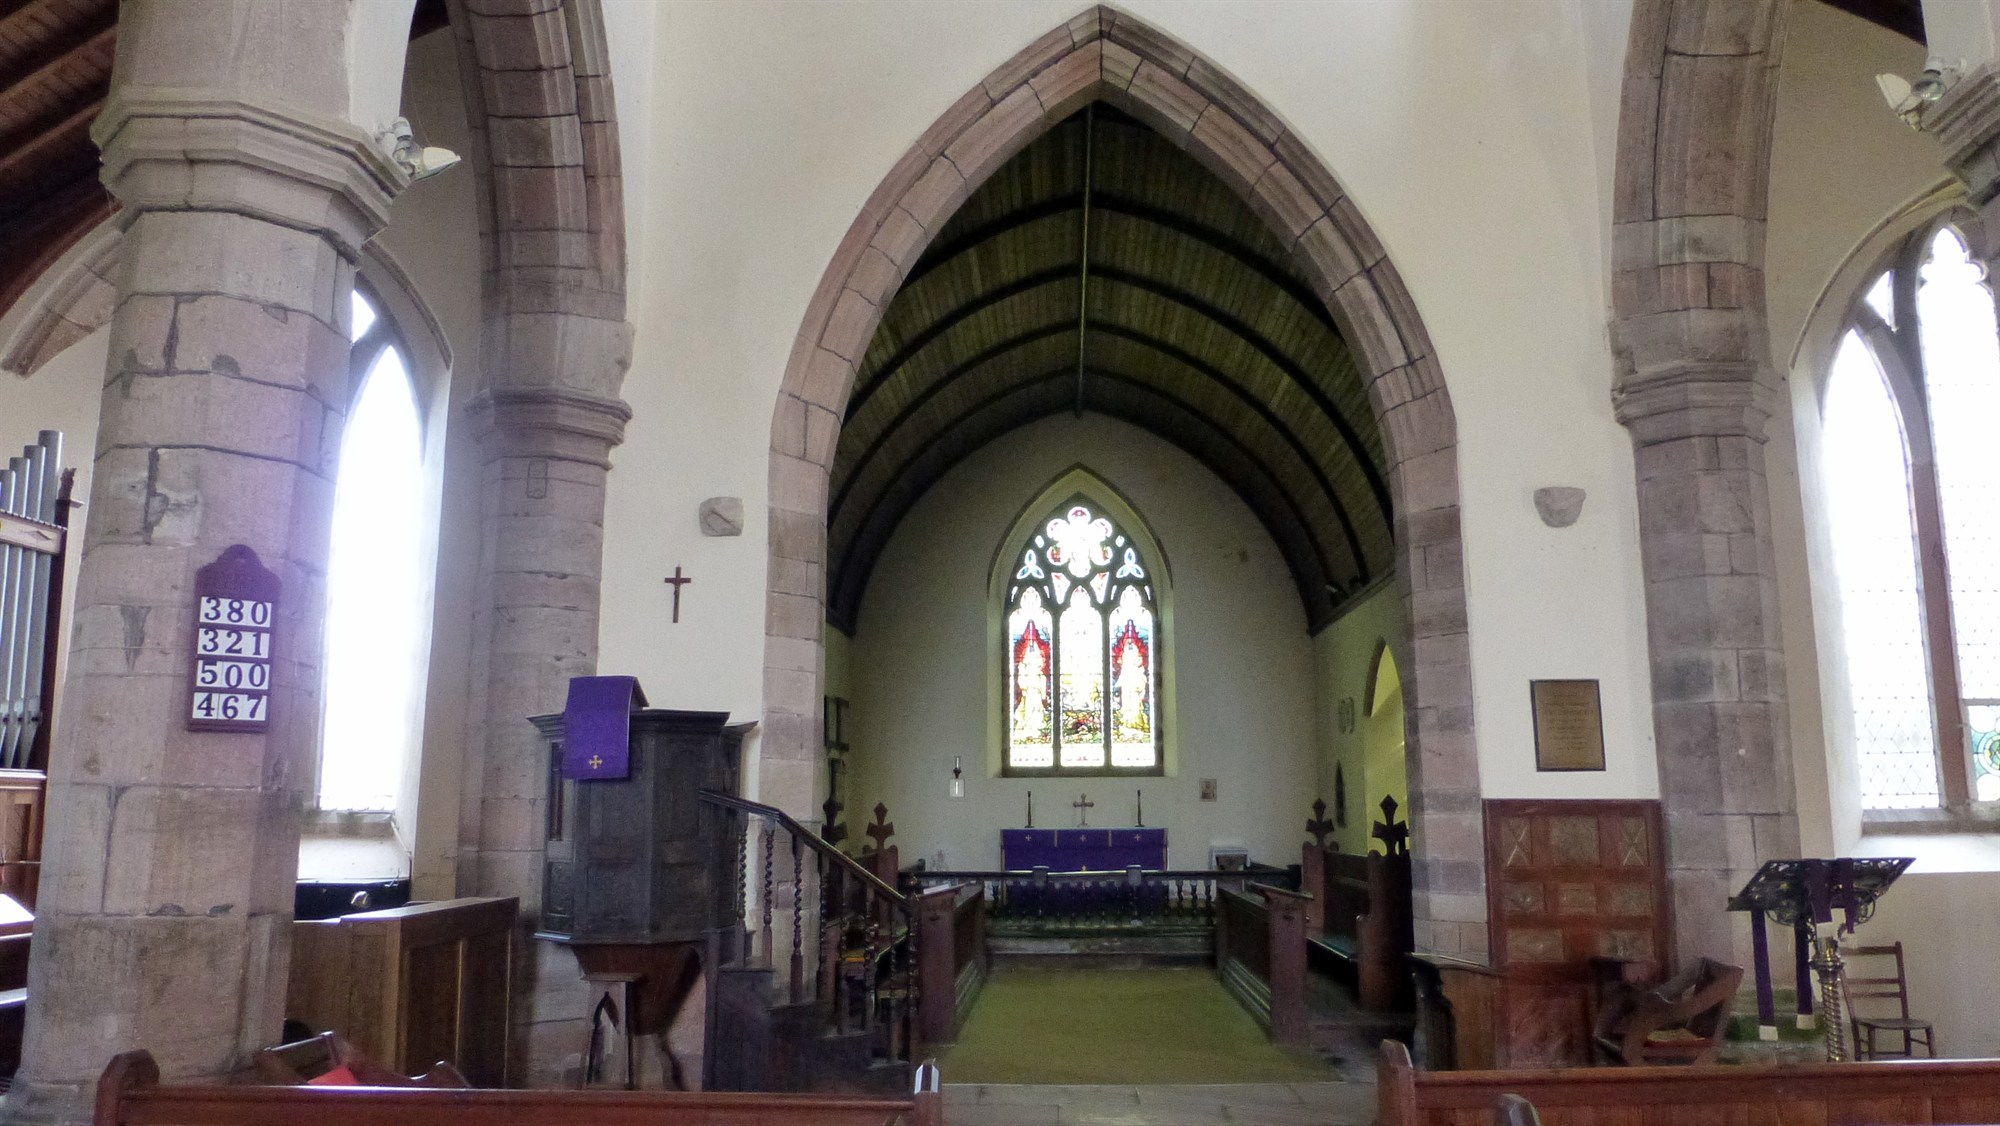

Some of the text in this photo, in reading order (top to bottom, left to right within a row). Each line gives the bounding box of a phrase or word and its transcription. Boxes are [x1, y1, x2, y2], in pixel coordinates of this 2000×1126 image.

[204, 597, 268, 625] 380
[202, 629, 262, 656] 321
[200, 660, 266, 688] 500
[197, 693, 263, 719] 467
